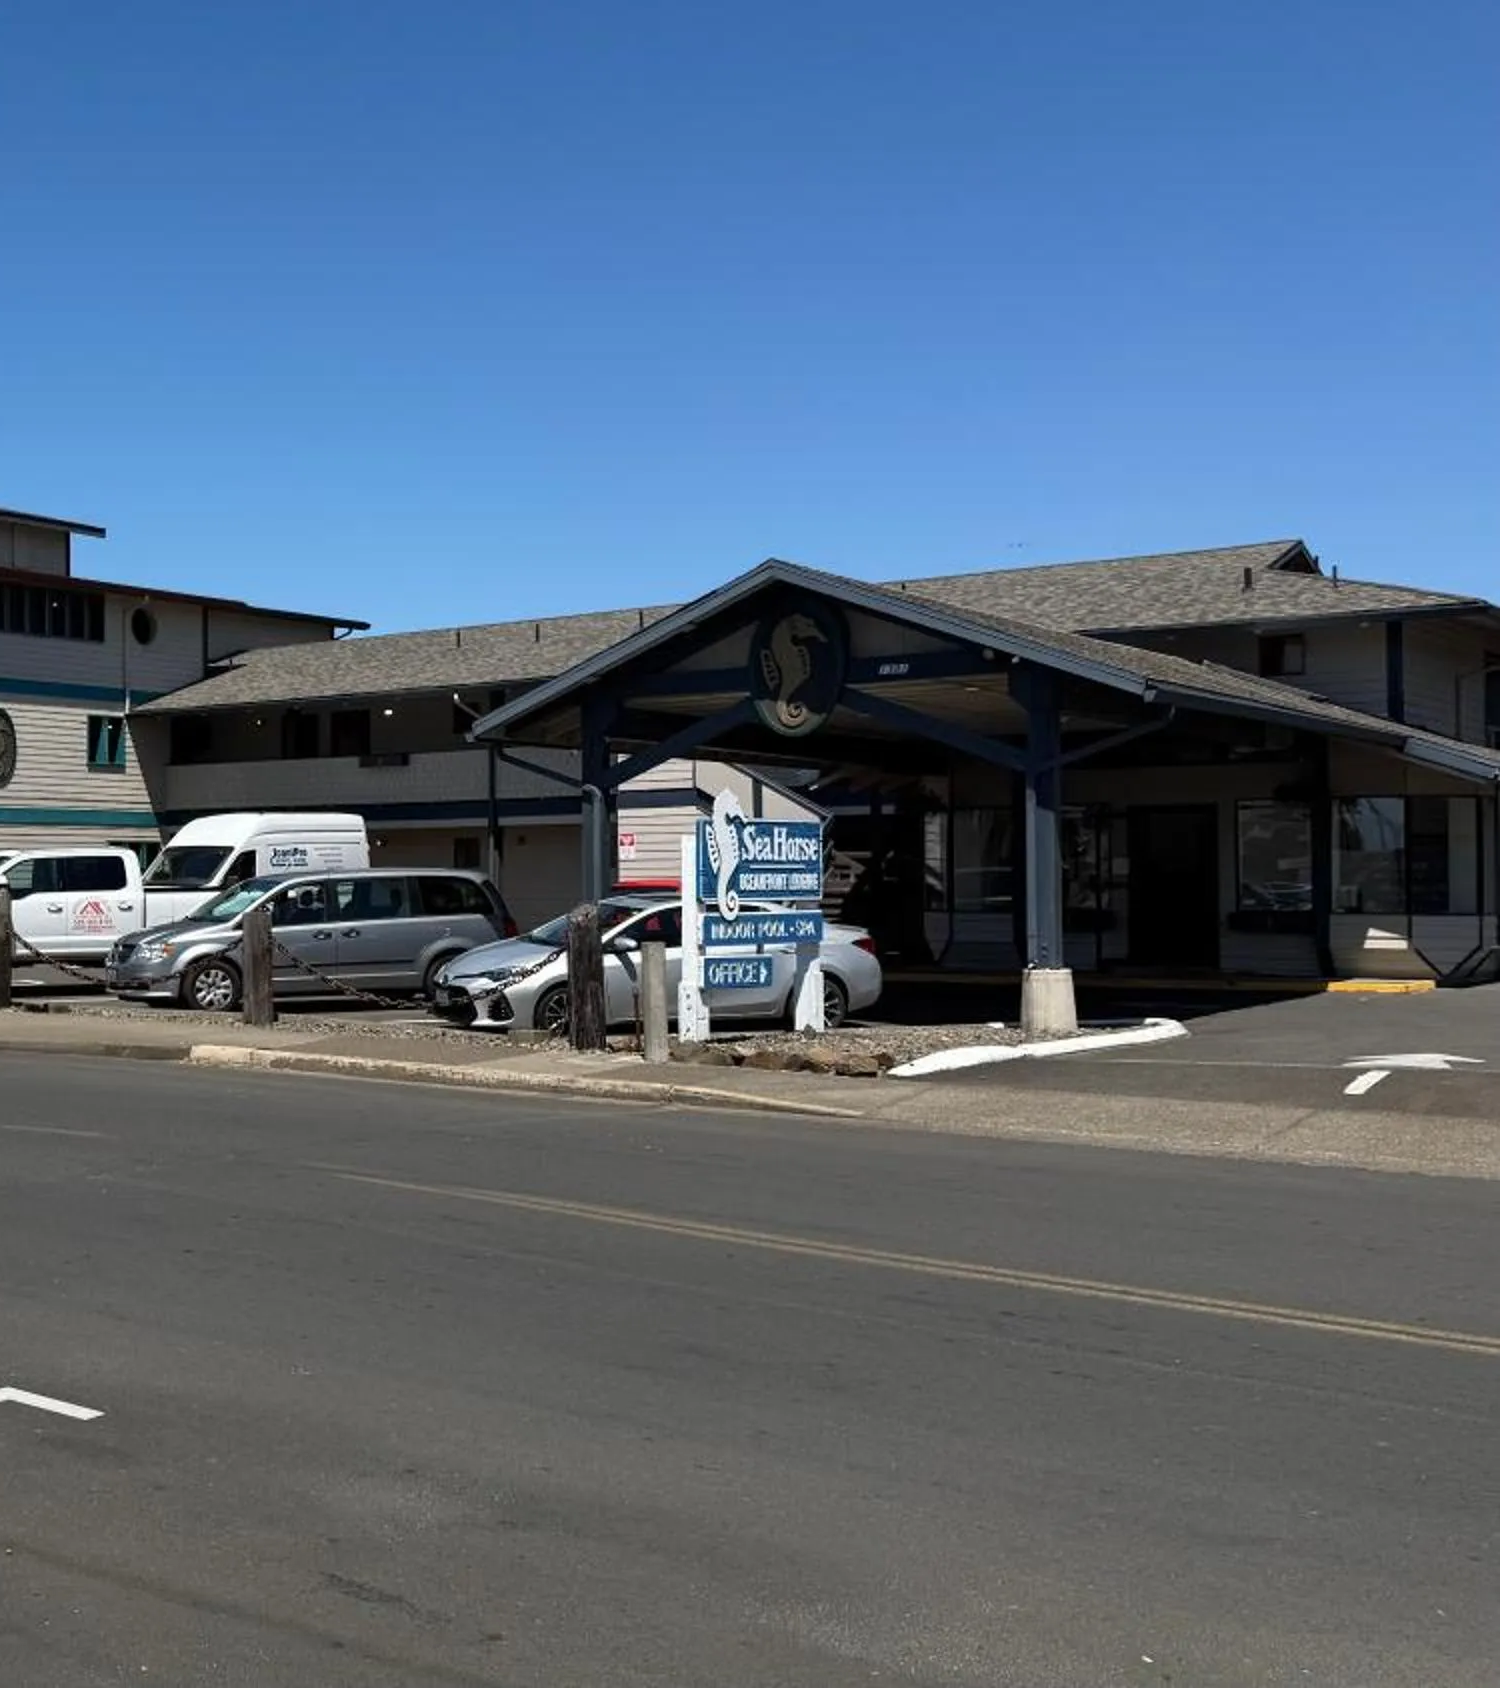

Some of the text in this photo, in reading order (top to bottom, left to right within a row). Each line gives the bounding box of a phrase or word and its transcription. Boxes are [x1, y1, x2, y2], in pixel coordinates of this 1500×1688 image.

[758, 920, 789, 938] POOL
[796, 919, 816, 937] SPA
[708, 962, 758, 984] OFFICE
